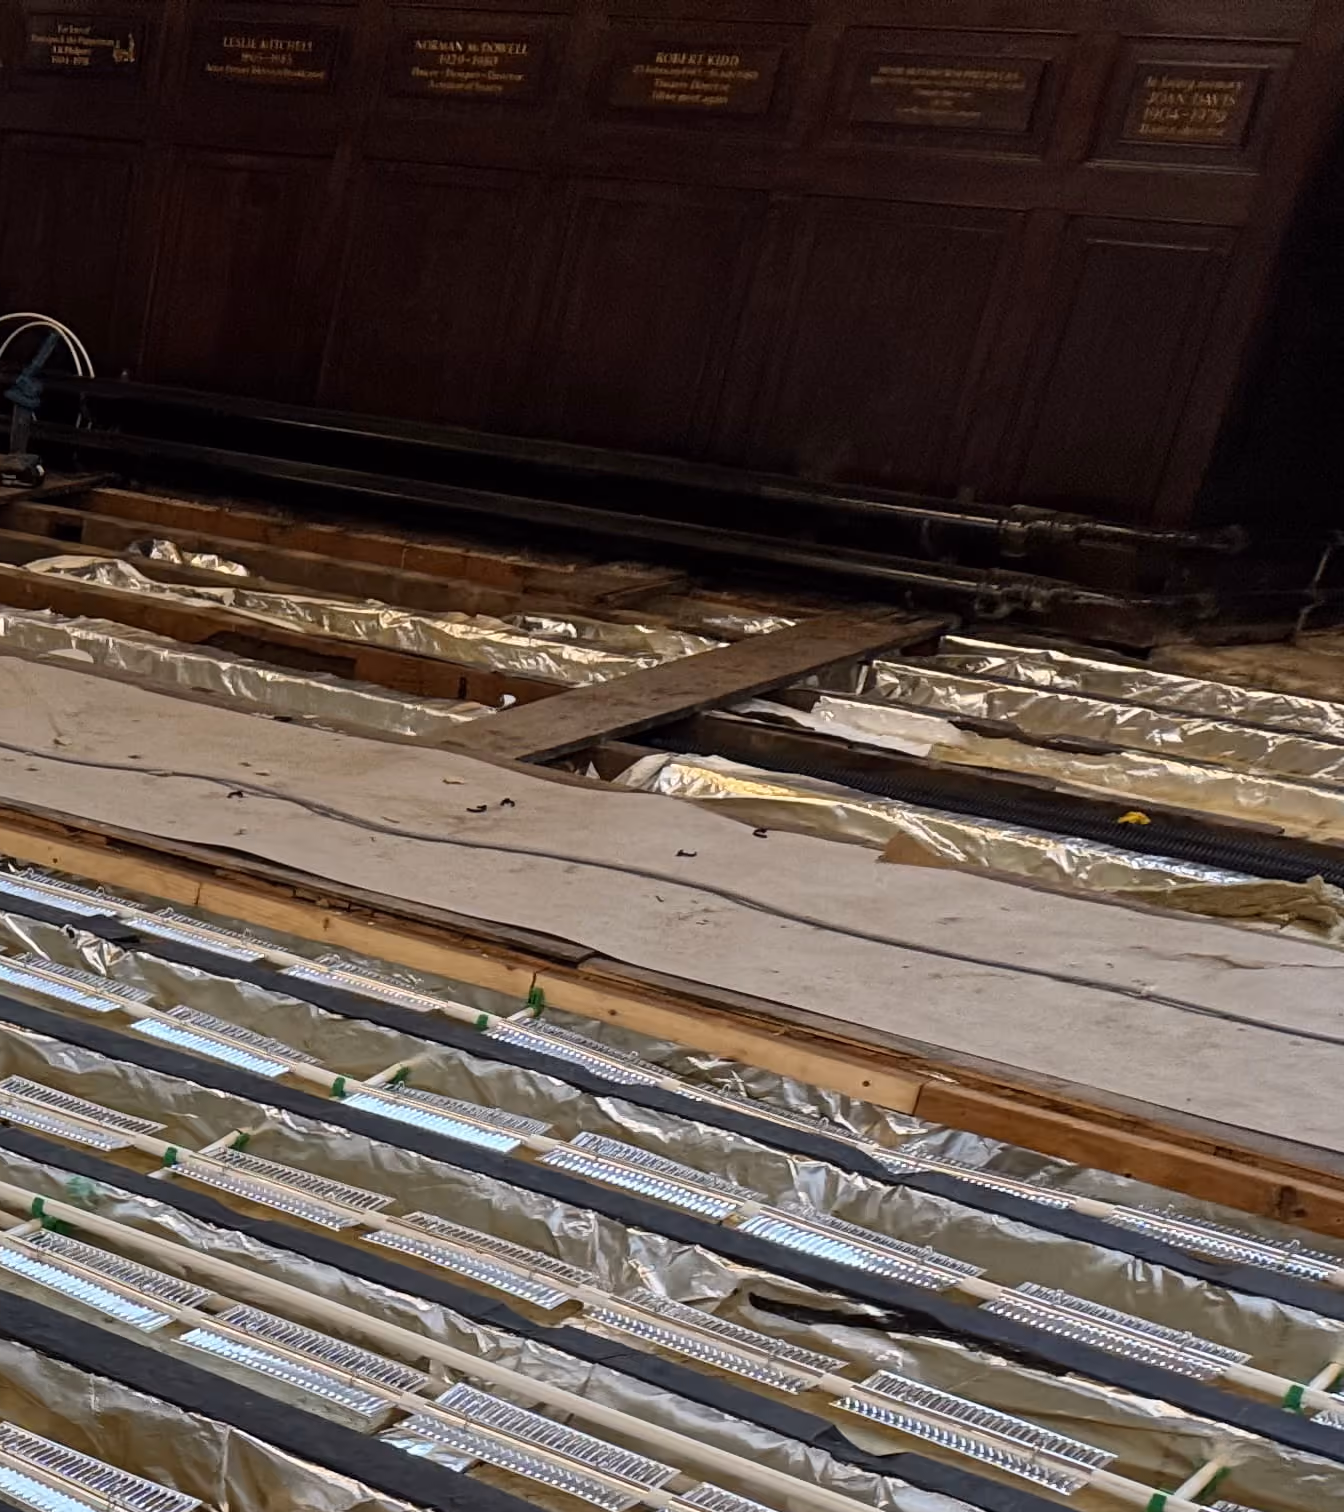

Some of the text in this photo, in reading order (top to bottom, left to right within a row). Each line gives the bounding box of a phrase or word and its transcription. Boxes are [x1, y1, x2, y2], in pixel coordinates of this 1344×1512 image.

[223, 37, 313, 52] LESLIE MITCHELL
[415, 39, 463, 52] NORMAN
[655, 52, 740, 66] ROBERT KIDD
[1146, 91, 1237, 106] JOAN DAVIS
